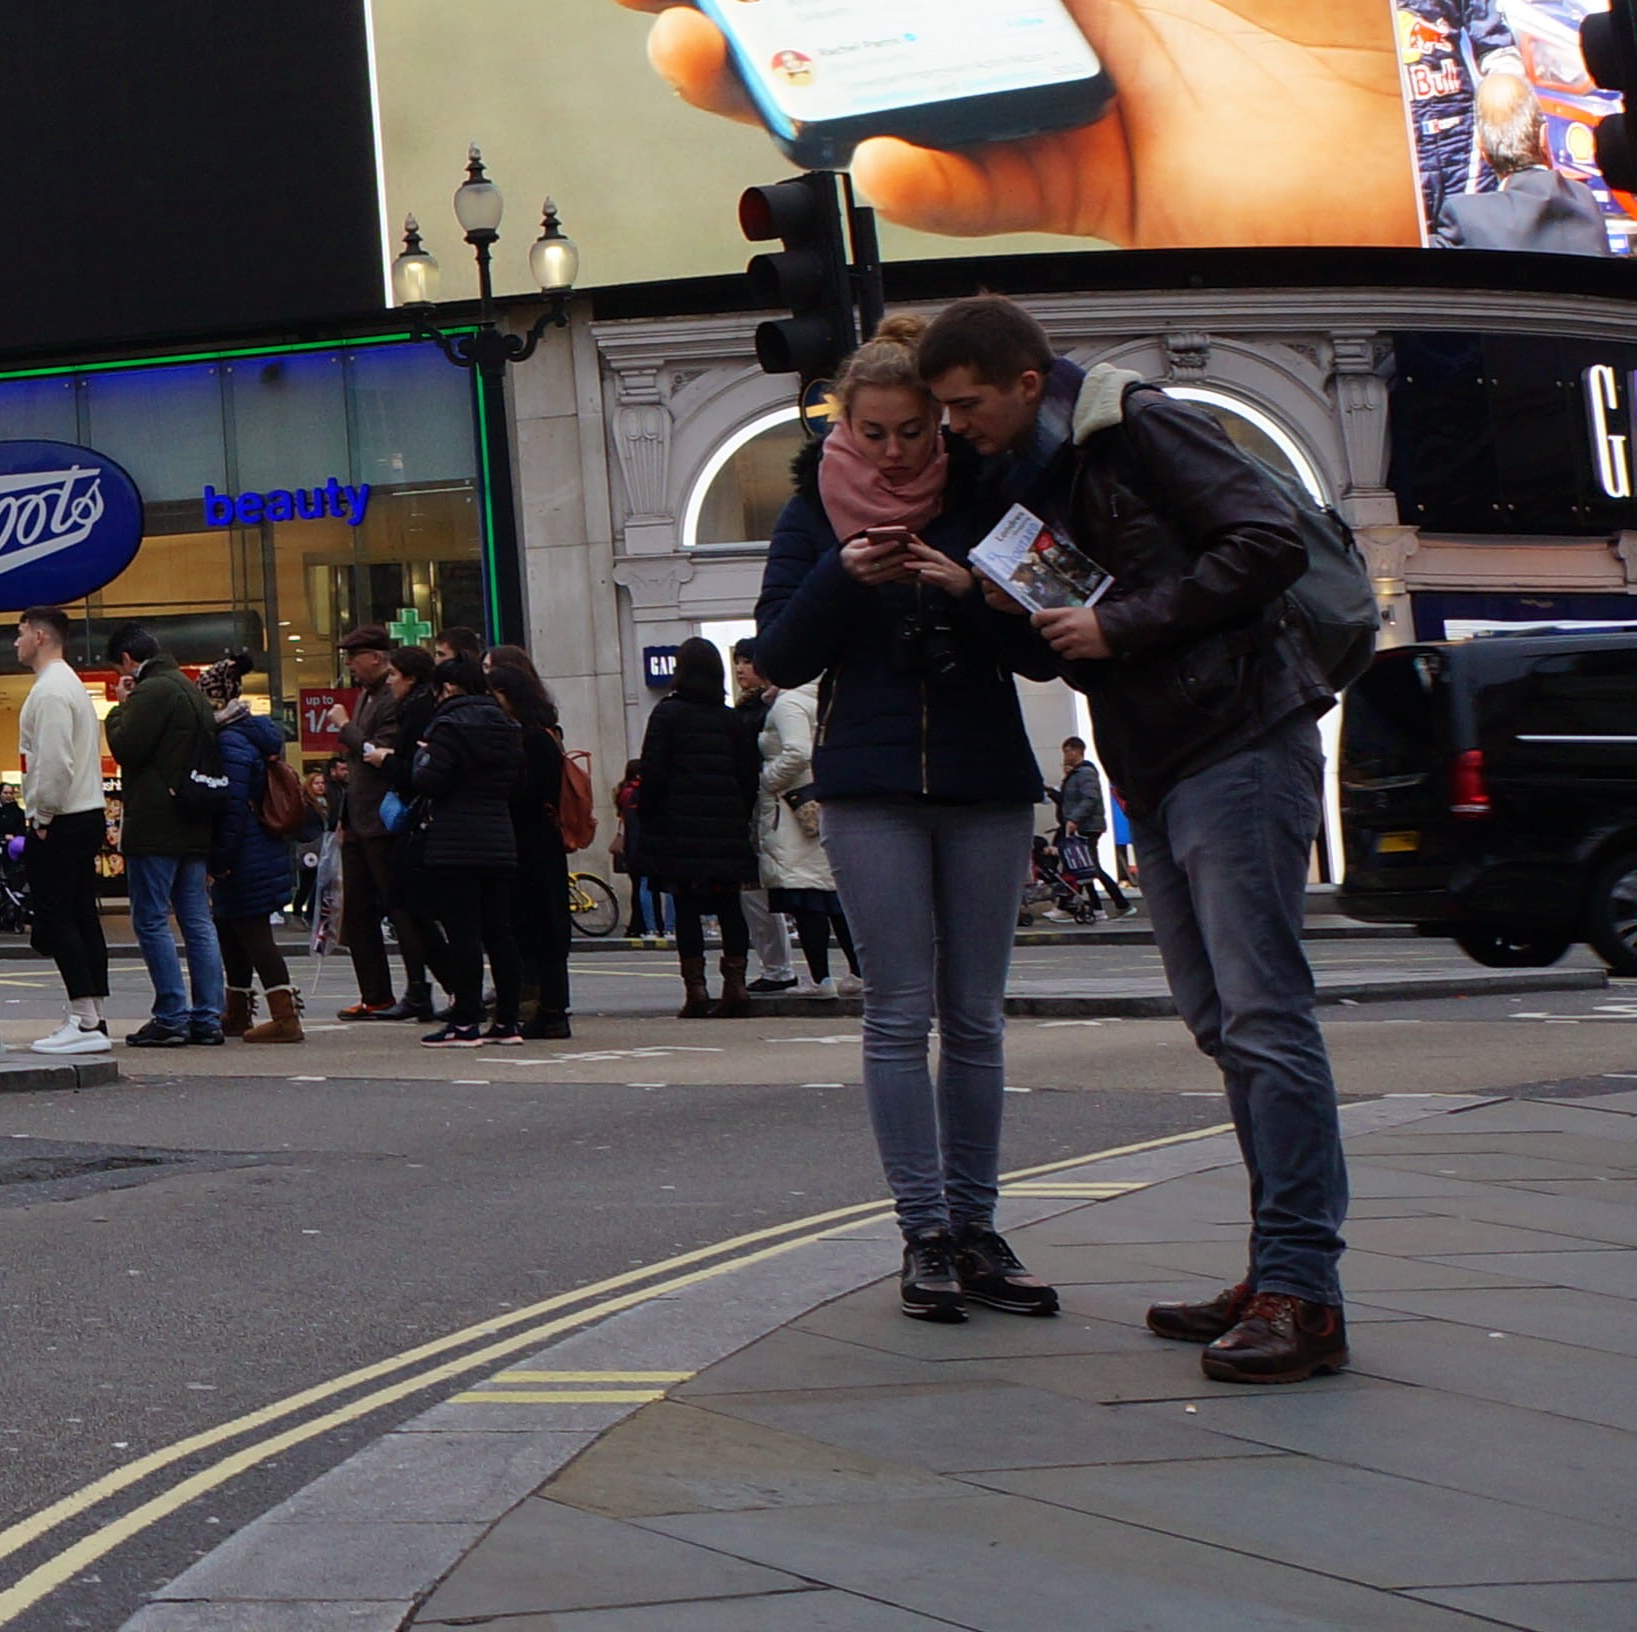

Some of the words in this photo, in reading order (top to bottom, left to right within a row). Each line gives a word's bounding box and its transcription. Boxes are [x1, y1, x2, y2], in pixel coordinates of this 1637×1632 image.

[203, 477, 371, 528] beauty
[650, 655, 677, 676] GAP
[305, 696, 320, 707] up
[322, 694, 334, 705] to
